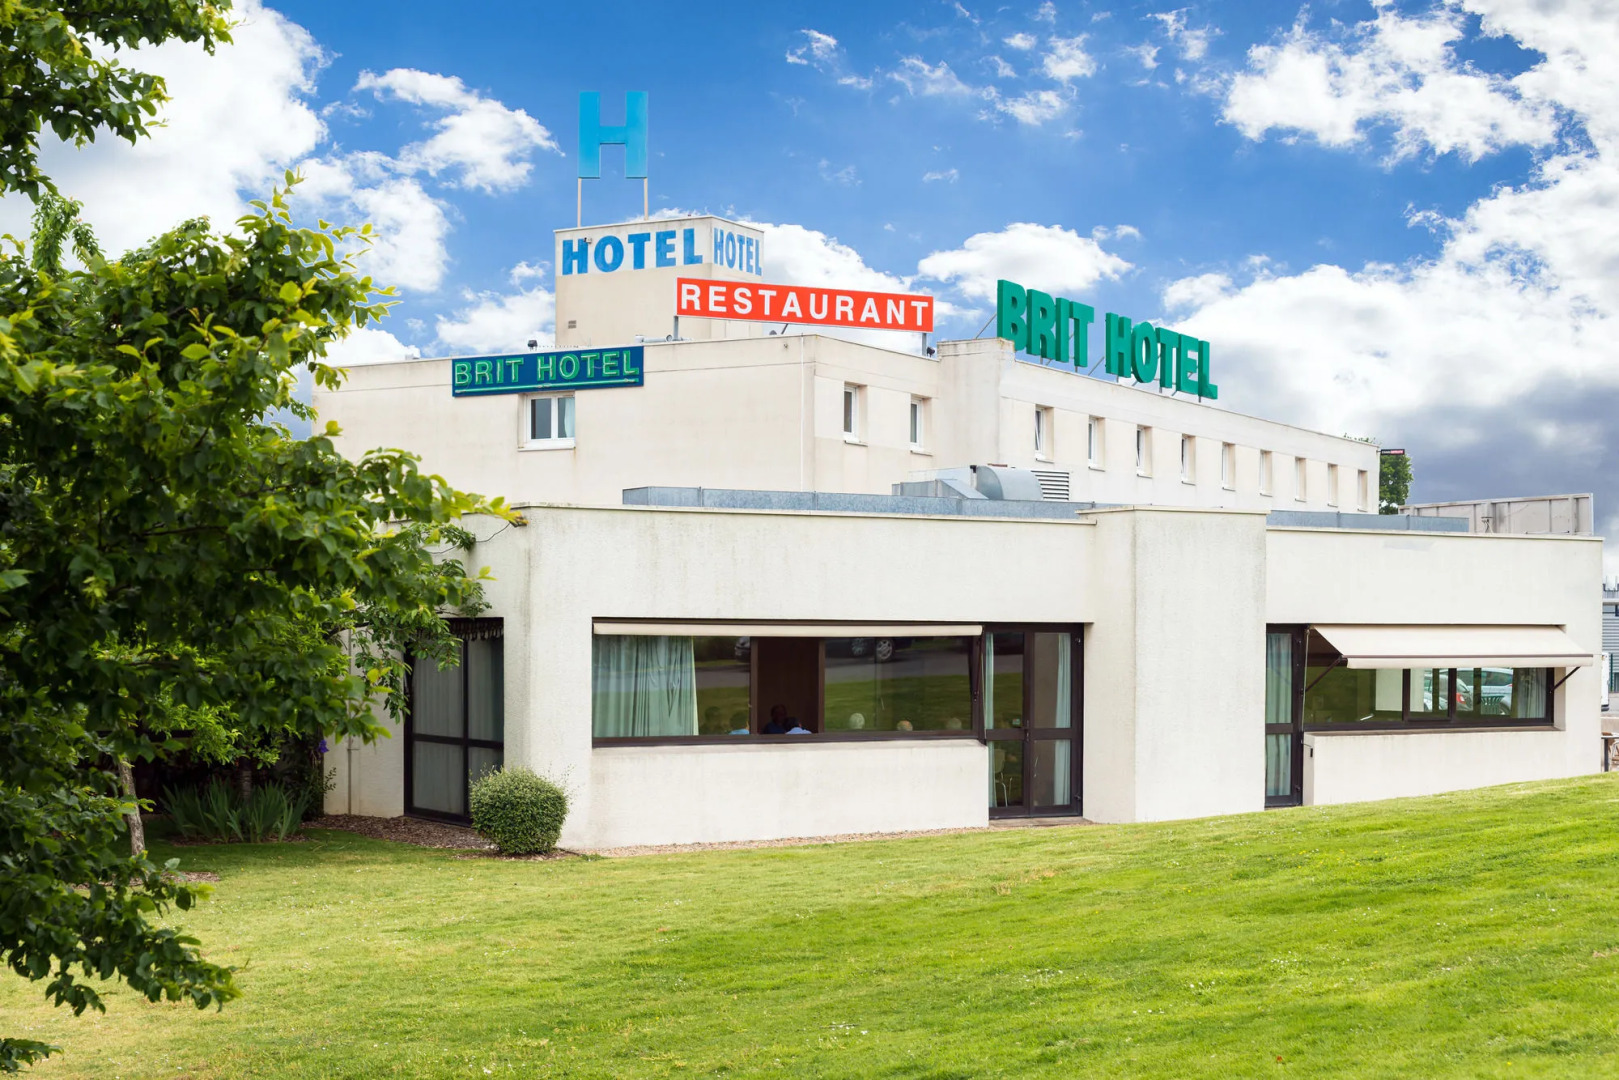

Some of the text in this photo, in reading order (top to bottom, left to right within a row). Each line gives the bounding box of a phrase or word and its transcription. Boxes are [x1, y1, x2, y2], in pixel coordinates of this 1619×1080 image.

[578, 90, 648, 179] H
[562, 228, 703, 276] HOTEL
[713, 227, 763, 277] HOTEL
[681, 283, 929, 327] RESTAURANT
[997, 279, 1218, 400] BRIT HOTEL
[455, 350, 639, 387] BRIT HOTEL
